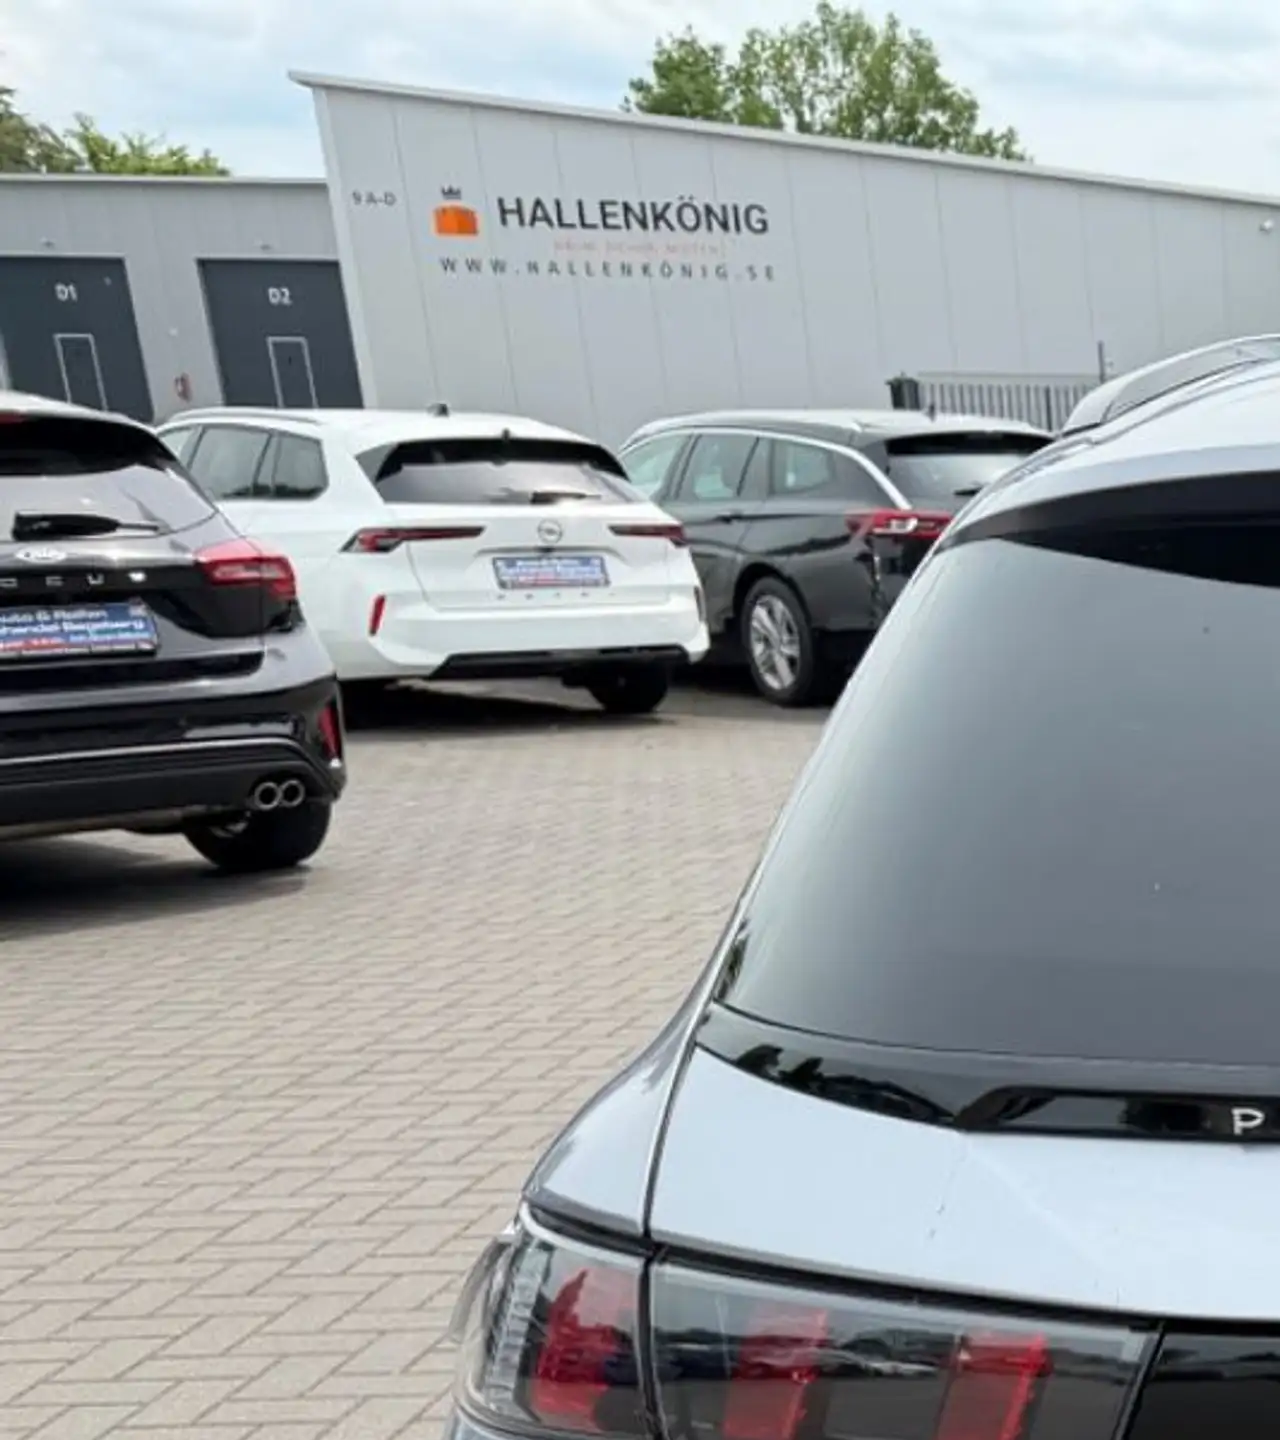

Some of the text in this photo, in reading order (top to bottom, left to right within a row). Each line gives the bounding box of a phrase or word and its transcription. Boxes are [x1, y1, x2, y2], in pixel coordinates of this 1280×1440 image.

[498, 195, 770, 235] HALLENKÖNIG
[55, 284, 77, 301] D1
[267, 286, 292, 305] D2
